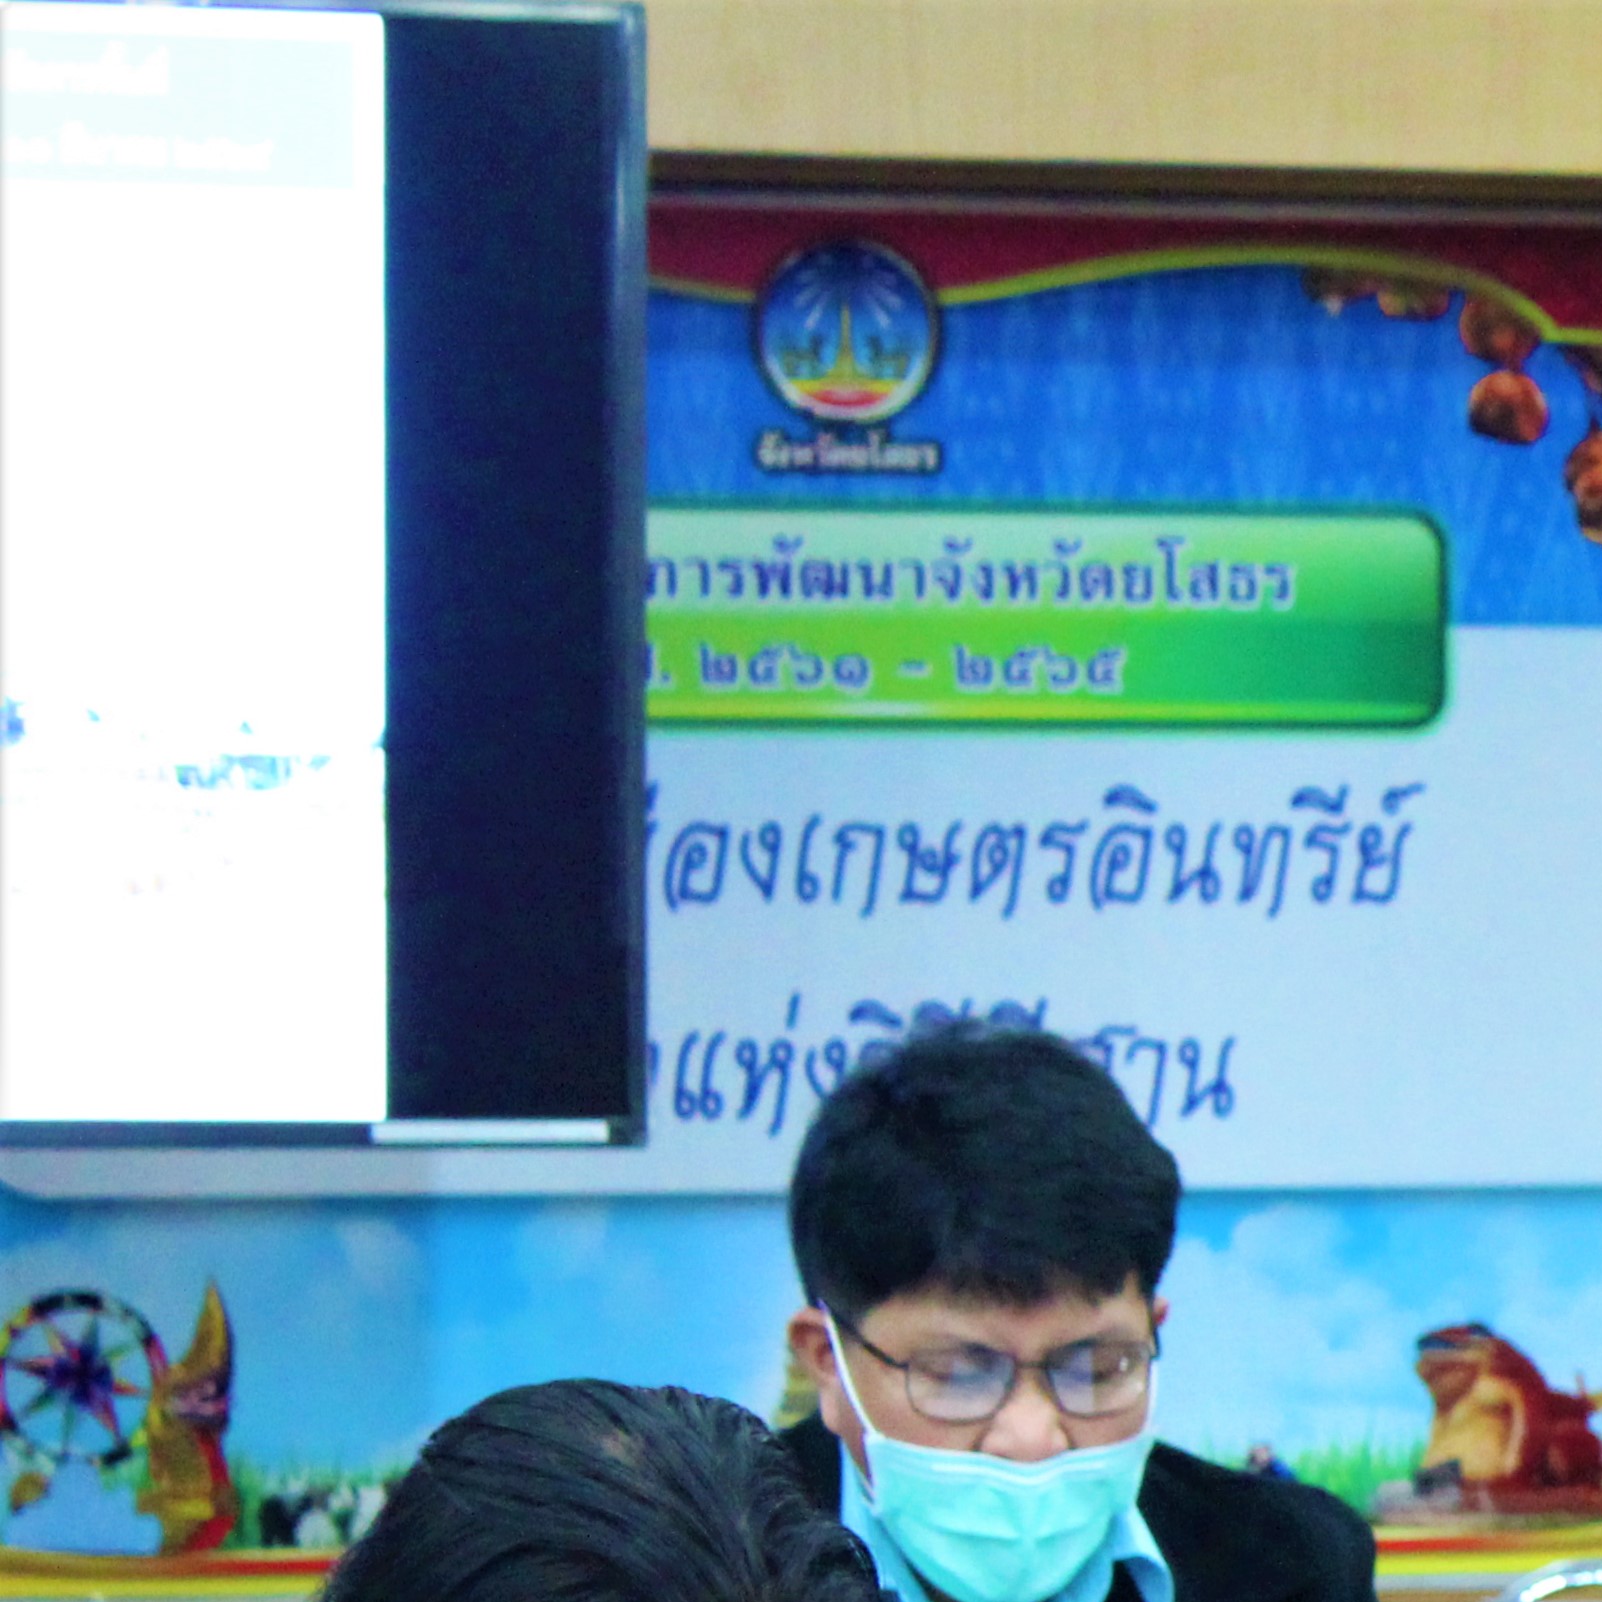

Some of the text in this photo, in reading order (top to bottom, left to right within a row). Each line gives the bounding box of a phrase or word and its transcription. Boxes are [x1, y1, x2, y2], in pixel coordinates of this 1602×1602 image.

[699, 640, 870, 690] ๒๕๖๑
[953, 643, 1126, 690] ๒๕๖๕
[645, 778, 1425, 918] องเกษตรอินทรีย์
